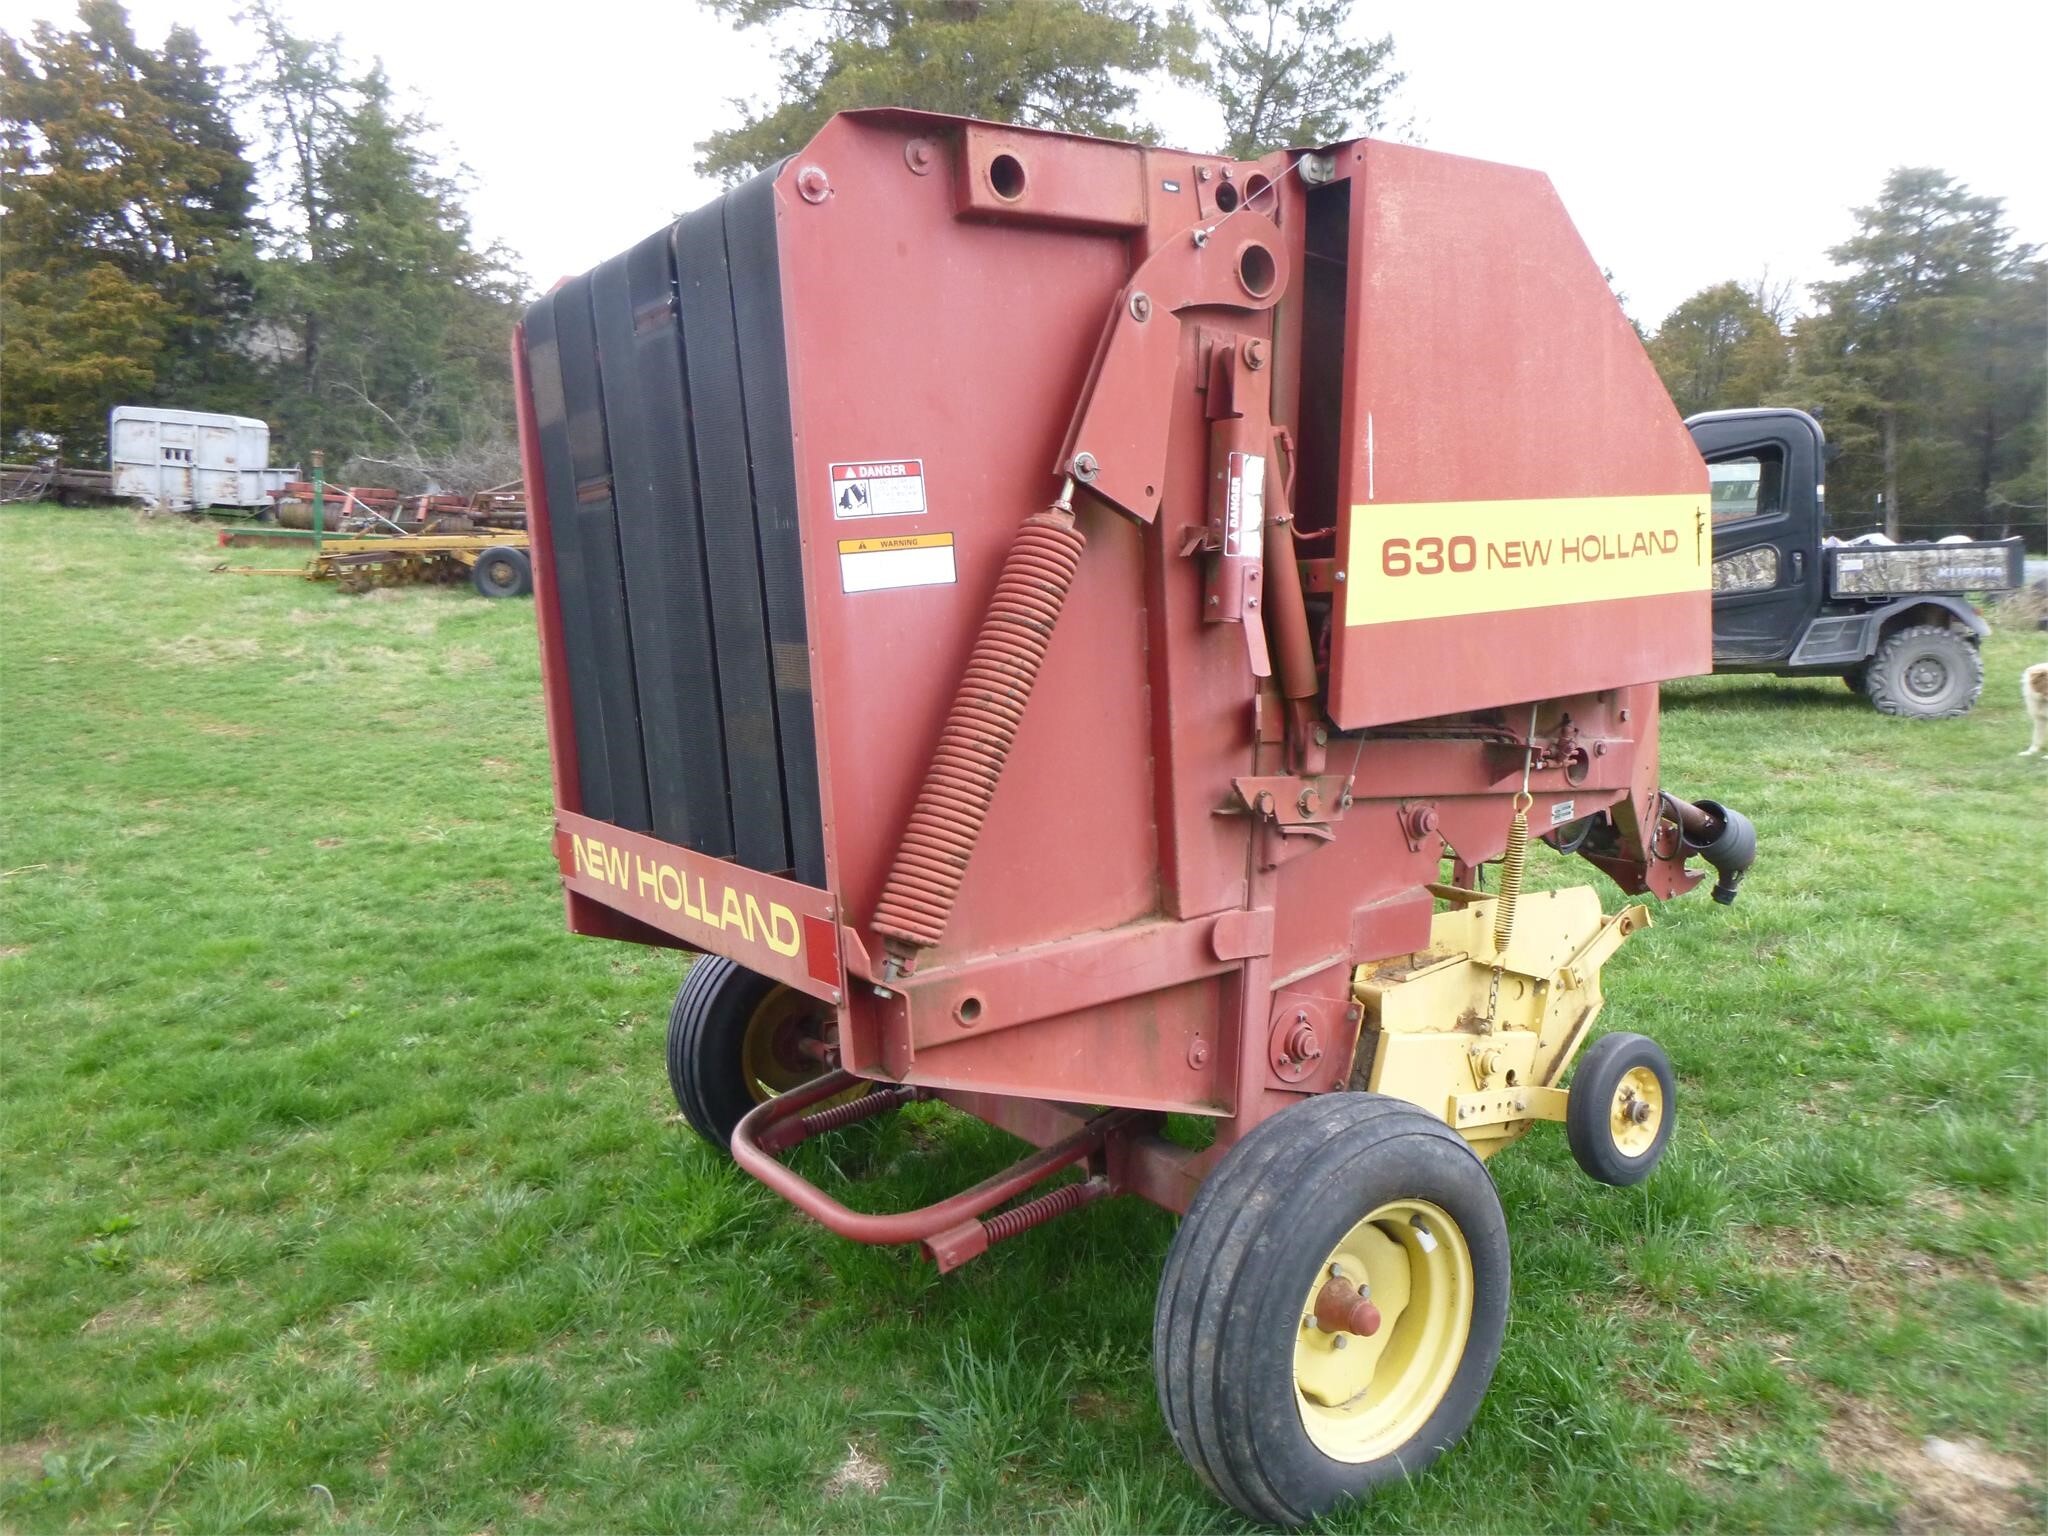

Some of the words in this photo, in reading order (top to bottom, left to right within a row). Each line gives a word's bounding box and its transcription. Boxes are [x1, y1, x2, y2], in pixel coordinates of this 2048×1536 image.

[859, 464, 906, 477] DANGER
[1230, 477, 1241, 528] DANGER
[880, 538, 918, 548] WARNING
[1381, 535, 1477, 577] 630
[1487, 539, 1552, 570] NEW
[1562, 529, 1679, 564] HOLLAND
[1936, 566, 2002, 578] KUBOTA
[572, 834, 629, 891] NEW
[636, 855, 801, 958] HOLLAND
